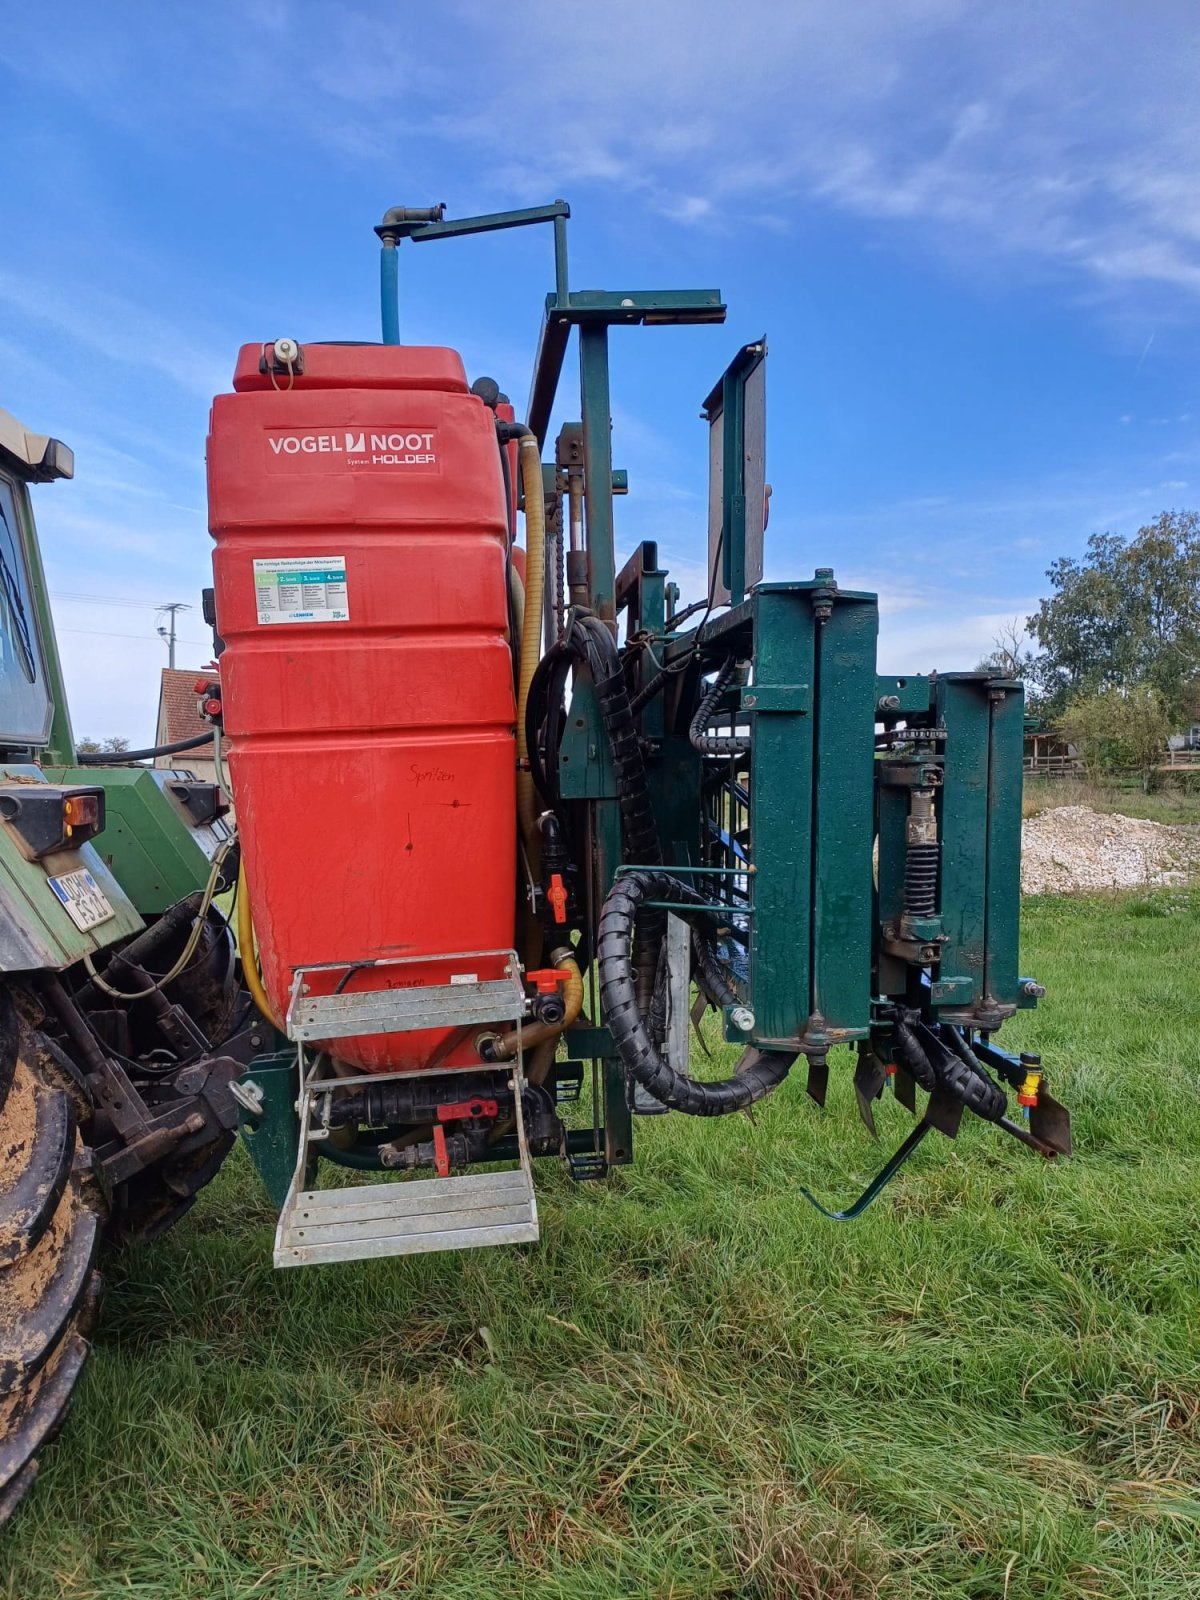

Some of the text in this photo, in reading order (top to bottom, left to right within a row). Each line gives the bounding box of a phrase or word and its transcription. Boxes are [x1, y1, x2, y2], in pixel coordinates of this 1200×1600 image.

[268, 433, 434, 454] VOGEL NOOT
[372, 454, 436, 464] HOLDER
